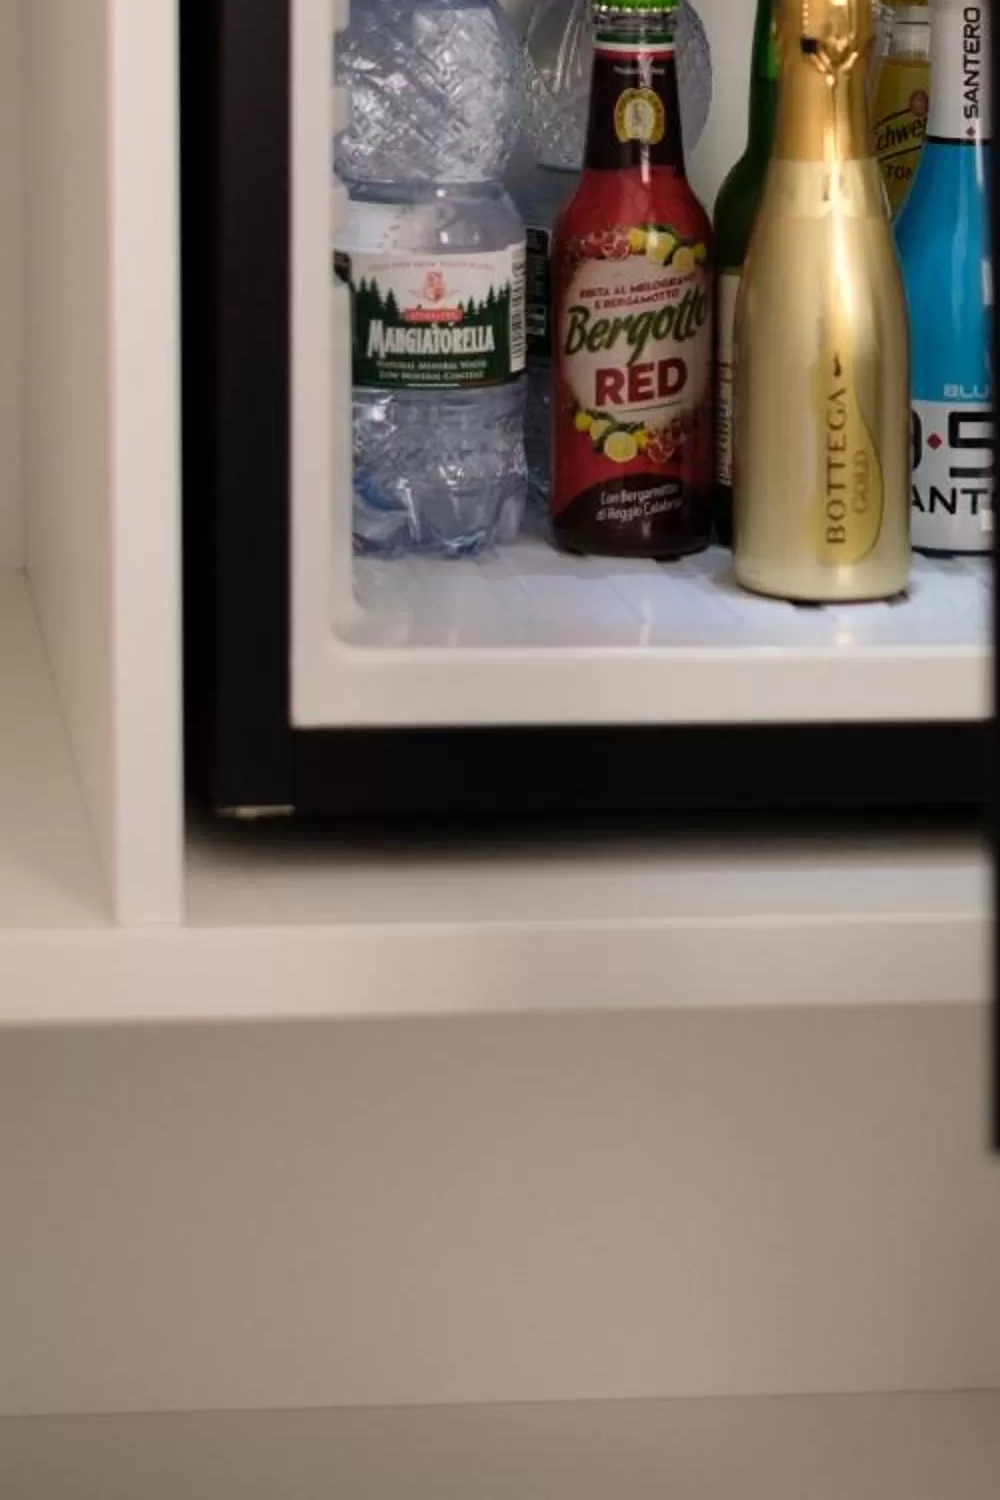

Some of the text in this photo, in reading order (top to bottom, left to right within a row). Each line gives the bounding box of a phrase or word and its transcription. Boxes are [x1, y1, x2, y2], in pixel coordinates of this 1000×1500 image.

[963, 7, 981, 119] SANTERO
[876, 116, 928, 150] chwe
[367, 319, 495, 358] MANGIATORELLA
[596, 357, 687, 407] RED
[943, 384, 989, 398] BLU
[826, 388, 847, 544] BOTTEGA
[911, 484, 989, 515] ANT
